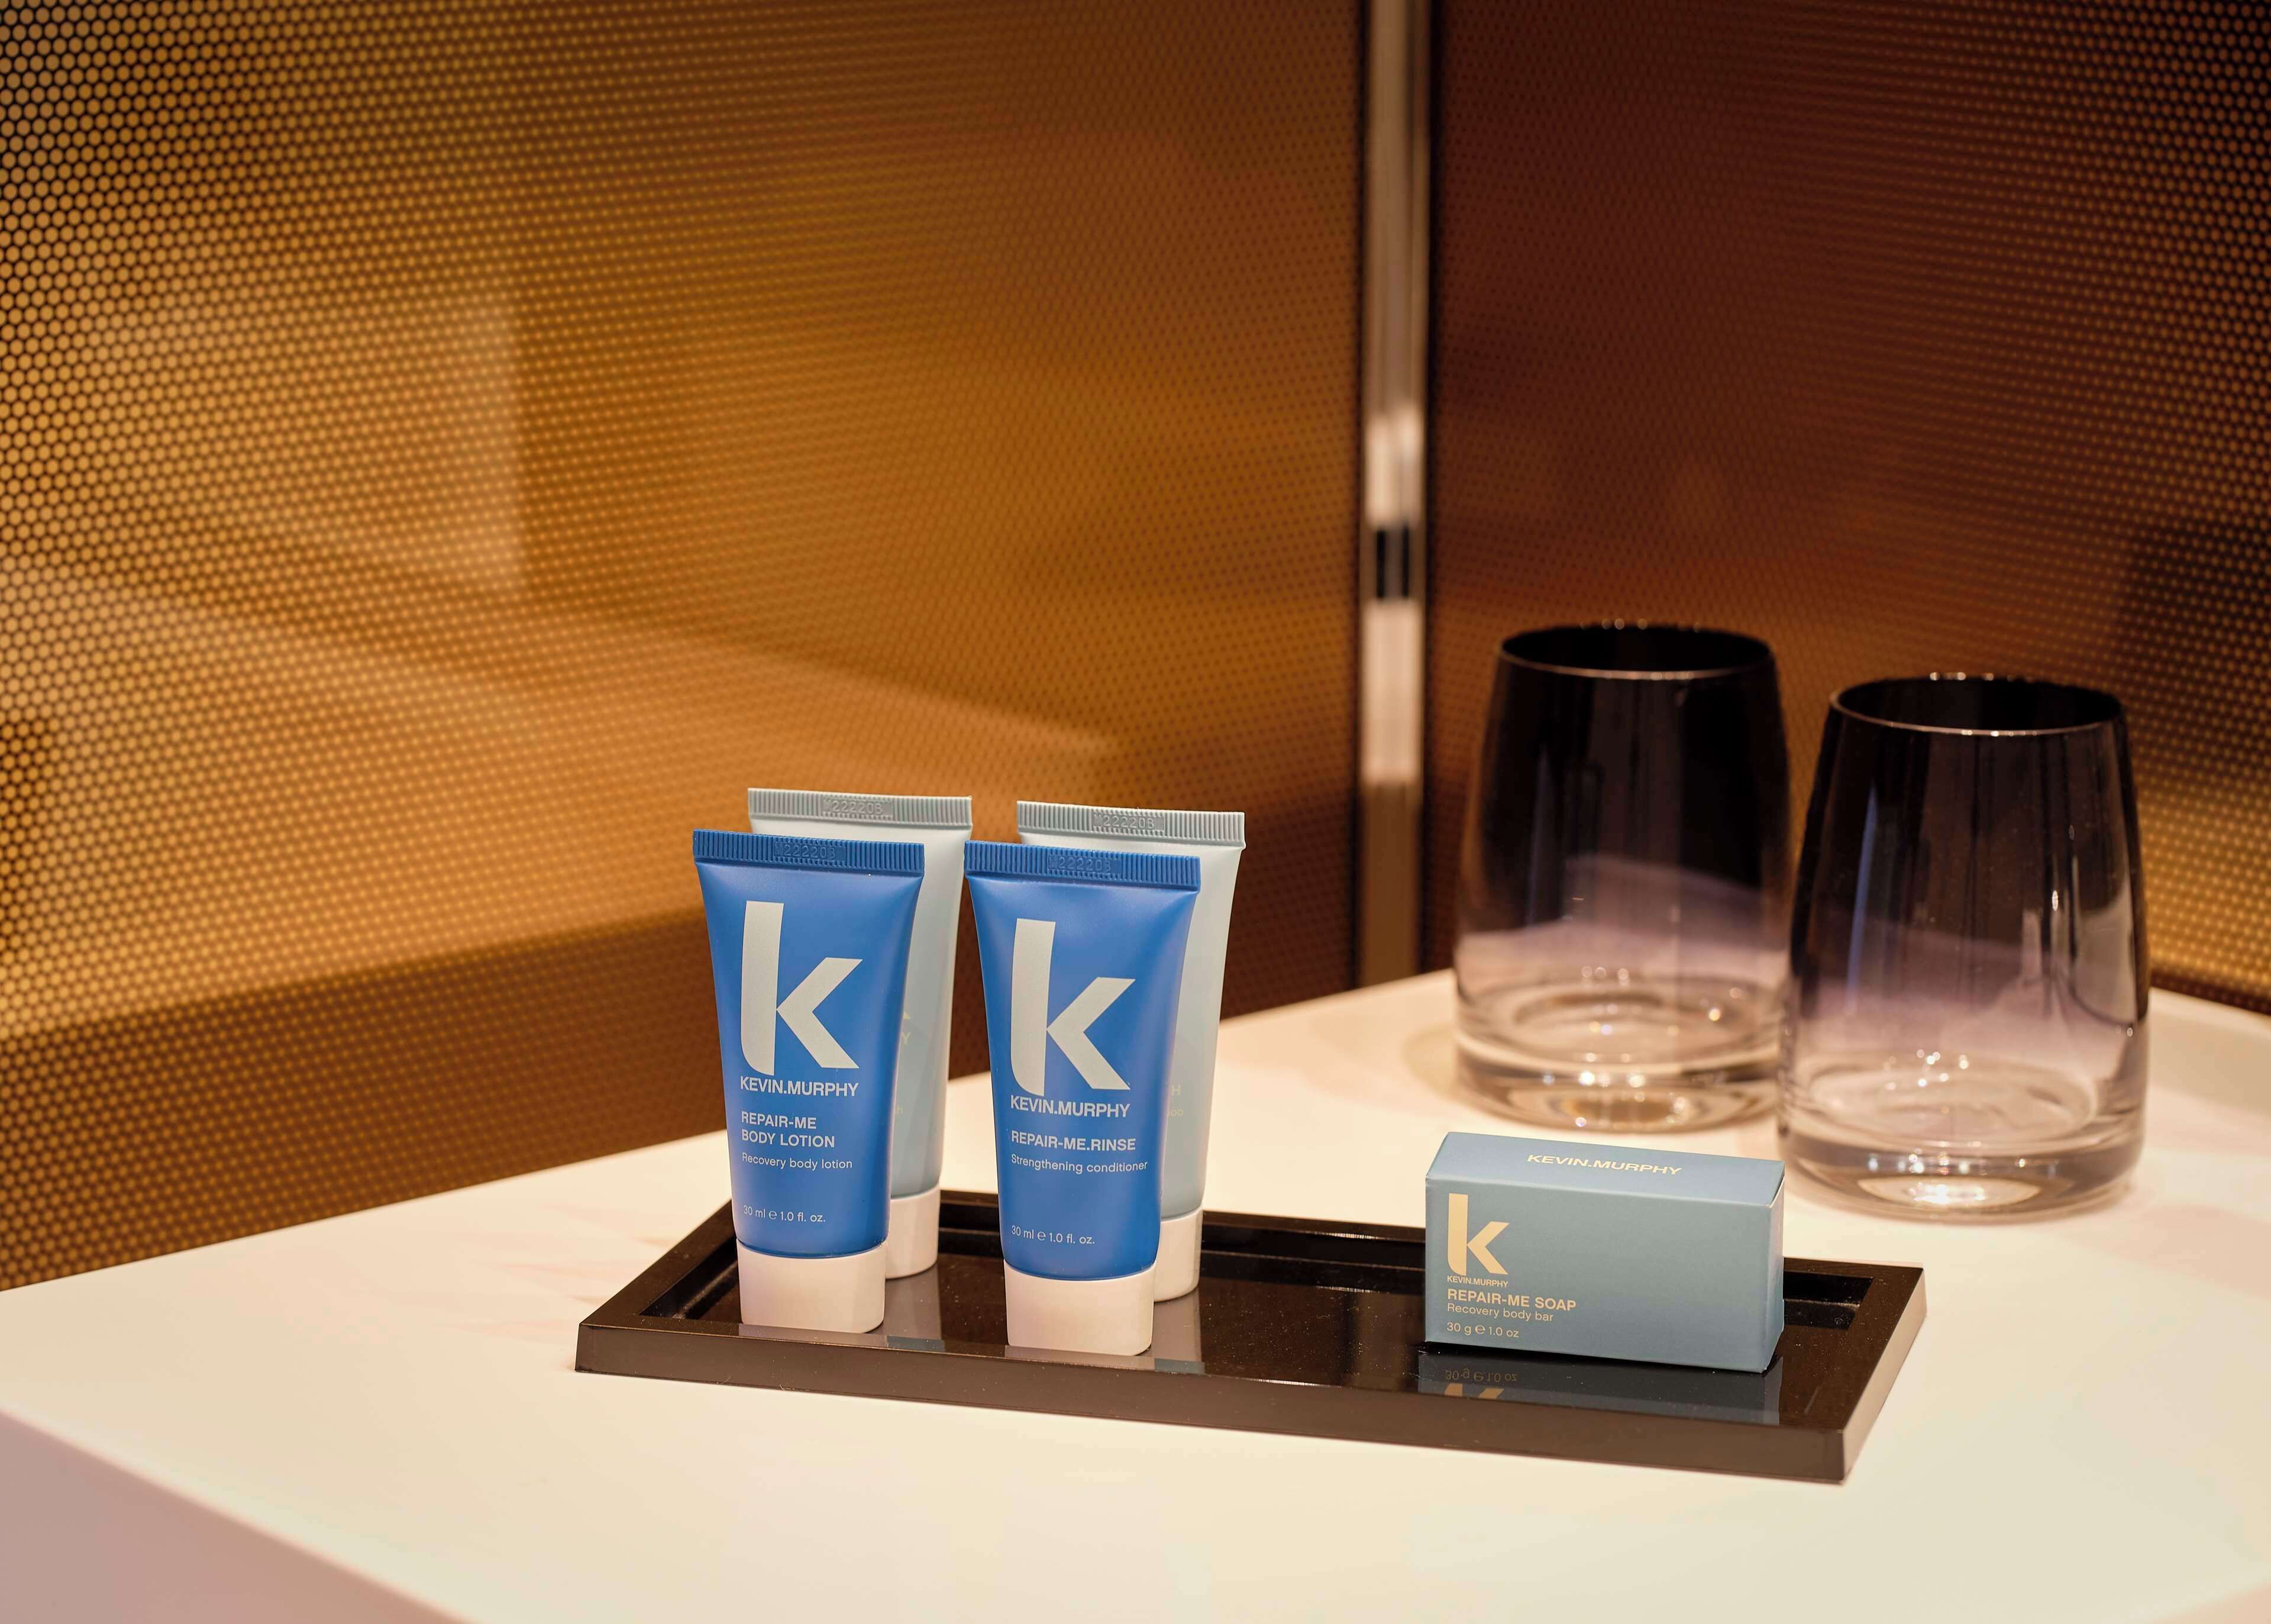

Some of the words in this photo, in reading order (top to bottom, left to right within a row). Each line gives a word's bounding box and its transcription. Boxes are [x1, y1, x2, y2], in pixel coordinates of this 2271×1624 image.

[740, 1076, 860, 1097] KEVIN.MURPHY
[1010, 1095, 1131, 1118] KEVIN.MURPHY
[741, 1111, 817, 1129] REPAIR-ME
[741, 1129, 776, 1145] BODY
[780, 1134, 835, 1148] LOTION
[1011, 1130, 1136, 1151] REPAIR-ME.RINSE
[742, 1152, 786, 1169] Recovery
[789, 1158, 818, 1171] body
[821, 1159, 852, 1169] lotion
[1011, 1154, 1083, 1174] Strengthening
[1086, 1160, 1148, 1173] conditioner
[1526, 1154, 1682, 1175] KEVIN.MURPHY
[743, 1205, 753, 1216] 30
[755, 1209, 765, 1219] ml
[780, 1211, 794, 1221] 1.0
[797, 1212, 806, 1222] fl.
[810, 1214, 826, 1223] oz.
[1012, 1225, 1021, 1236] 30
[1023, 1229, 1035, 1239] ml
[1049, 1232, 1063, 1243] 1.0
[1066, 1234, 1075, 1244] fl.
[1079, 1236, 1095, 1244] oz.
[1447, 1275, 1508, 1288] KEVIN.MURPHY
[1448, 1288, 1530, 1307] REPAIR-ME
[1535, 1296, 1577, 1311] SOAP
[1448, 1303, 1500, 1319] Recovery
[1503, 1307, 1532, 1322] body
[1535, 1311, 1554, 1321] bar
[1447, 1322, 1461, 1332] 30
[1464, 1326, 1472, 1335] g
[1488, 1326, 1503, 1336] 1.0
[1506, 1329, 1519, 1338] oz
